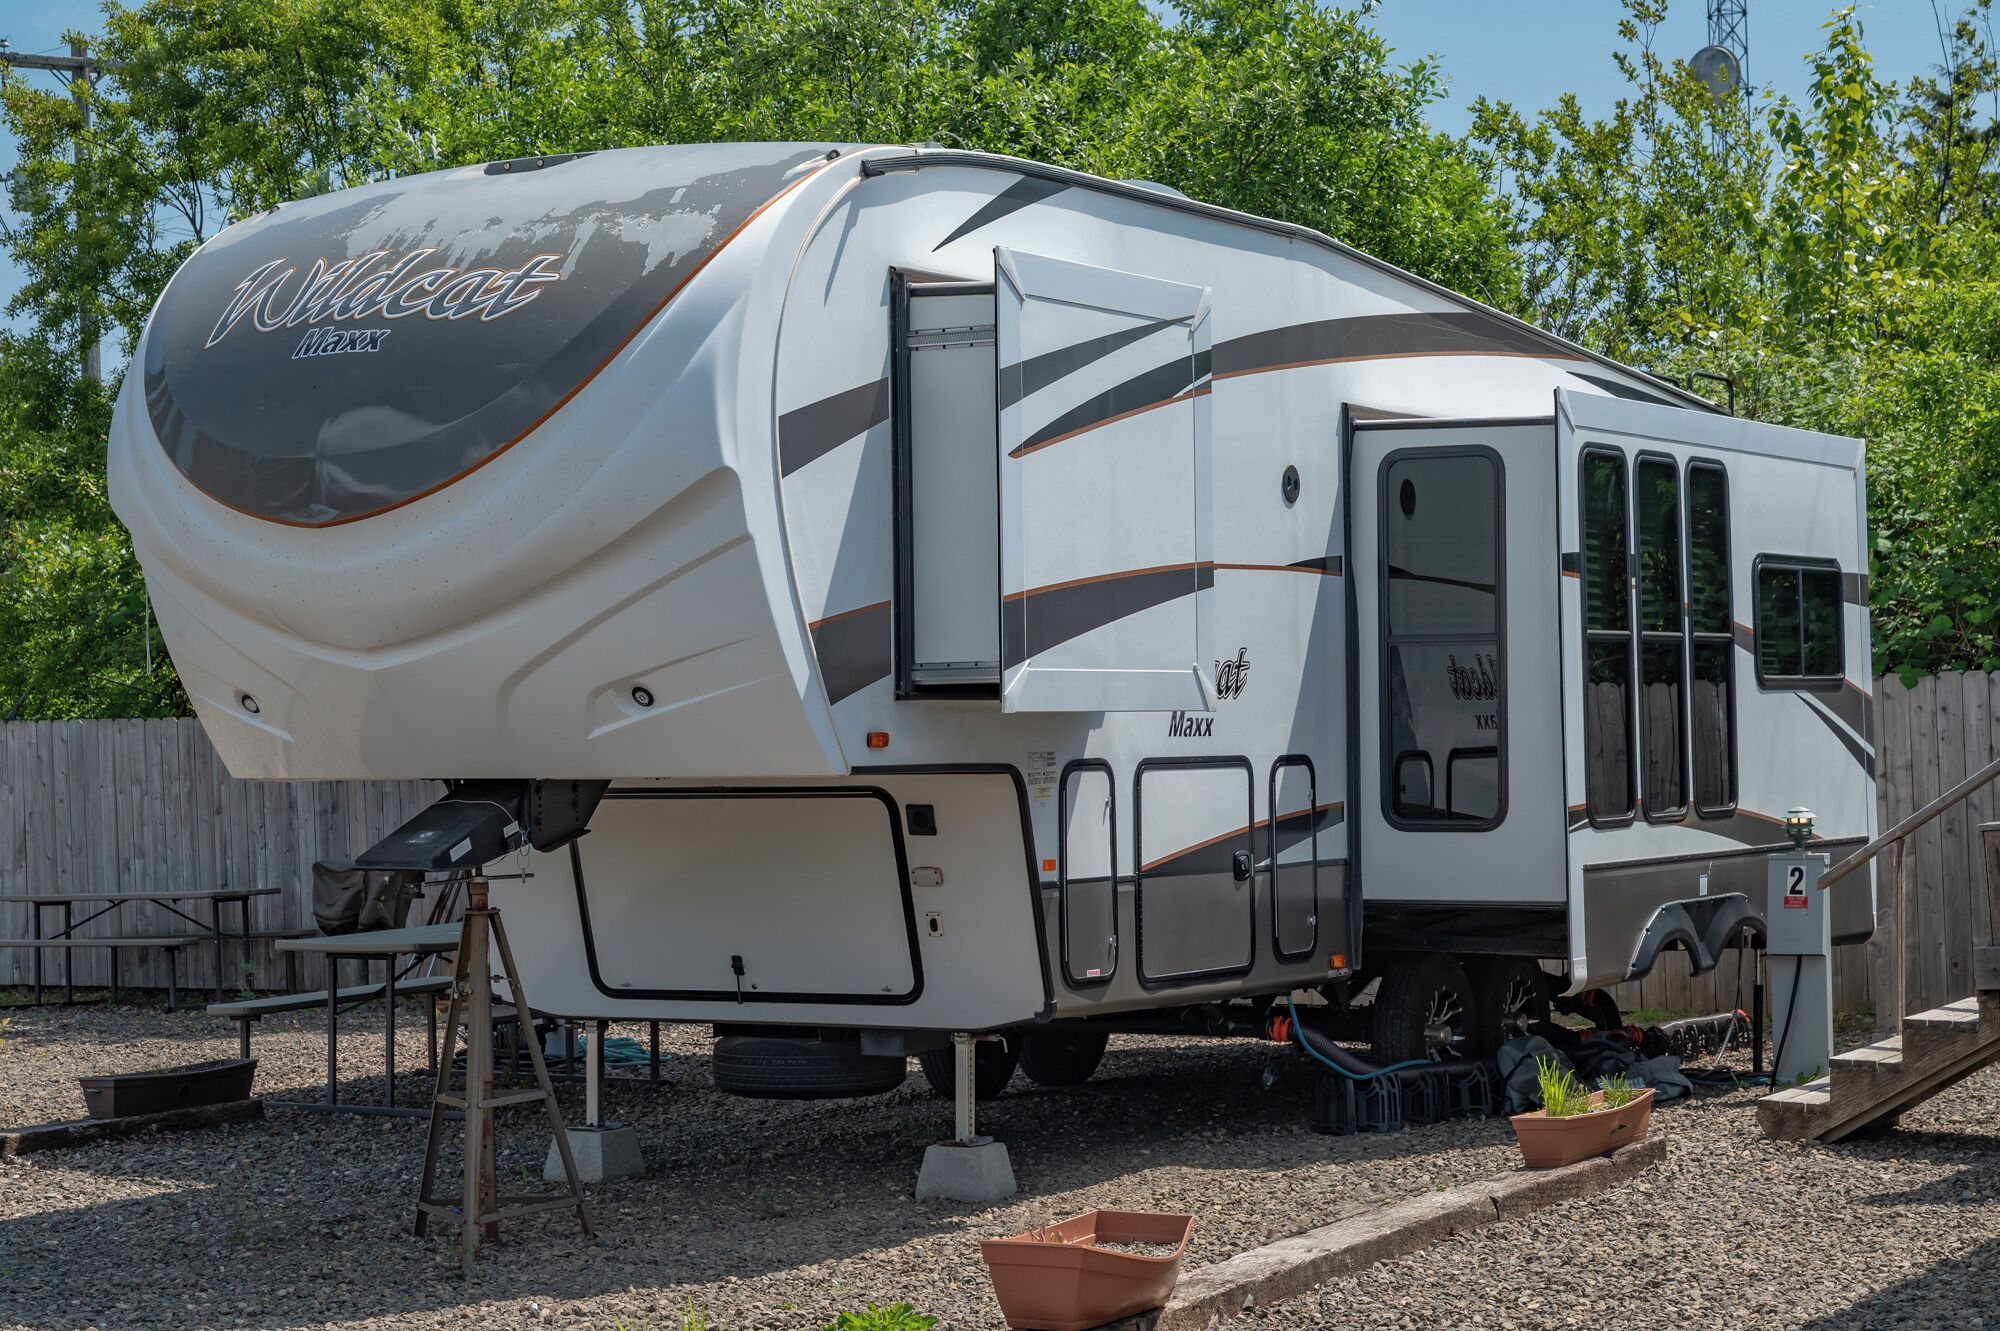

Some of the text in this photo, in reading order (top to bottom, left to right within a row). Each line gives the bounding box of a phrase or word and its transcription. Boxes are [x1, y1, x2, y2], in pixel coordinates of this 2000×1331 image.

[204, 248, 563, 351] Wildcat
[292, 326, 391, 360] Maxx
[1214, 647, 1250, 700] at
[1168, 711, 1214, 737] Maxx
[1790, 867, 1804, 895] 2
